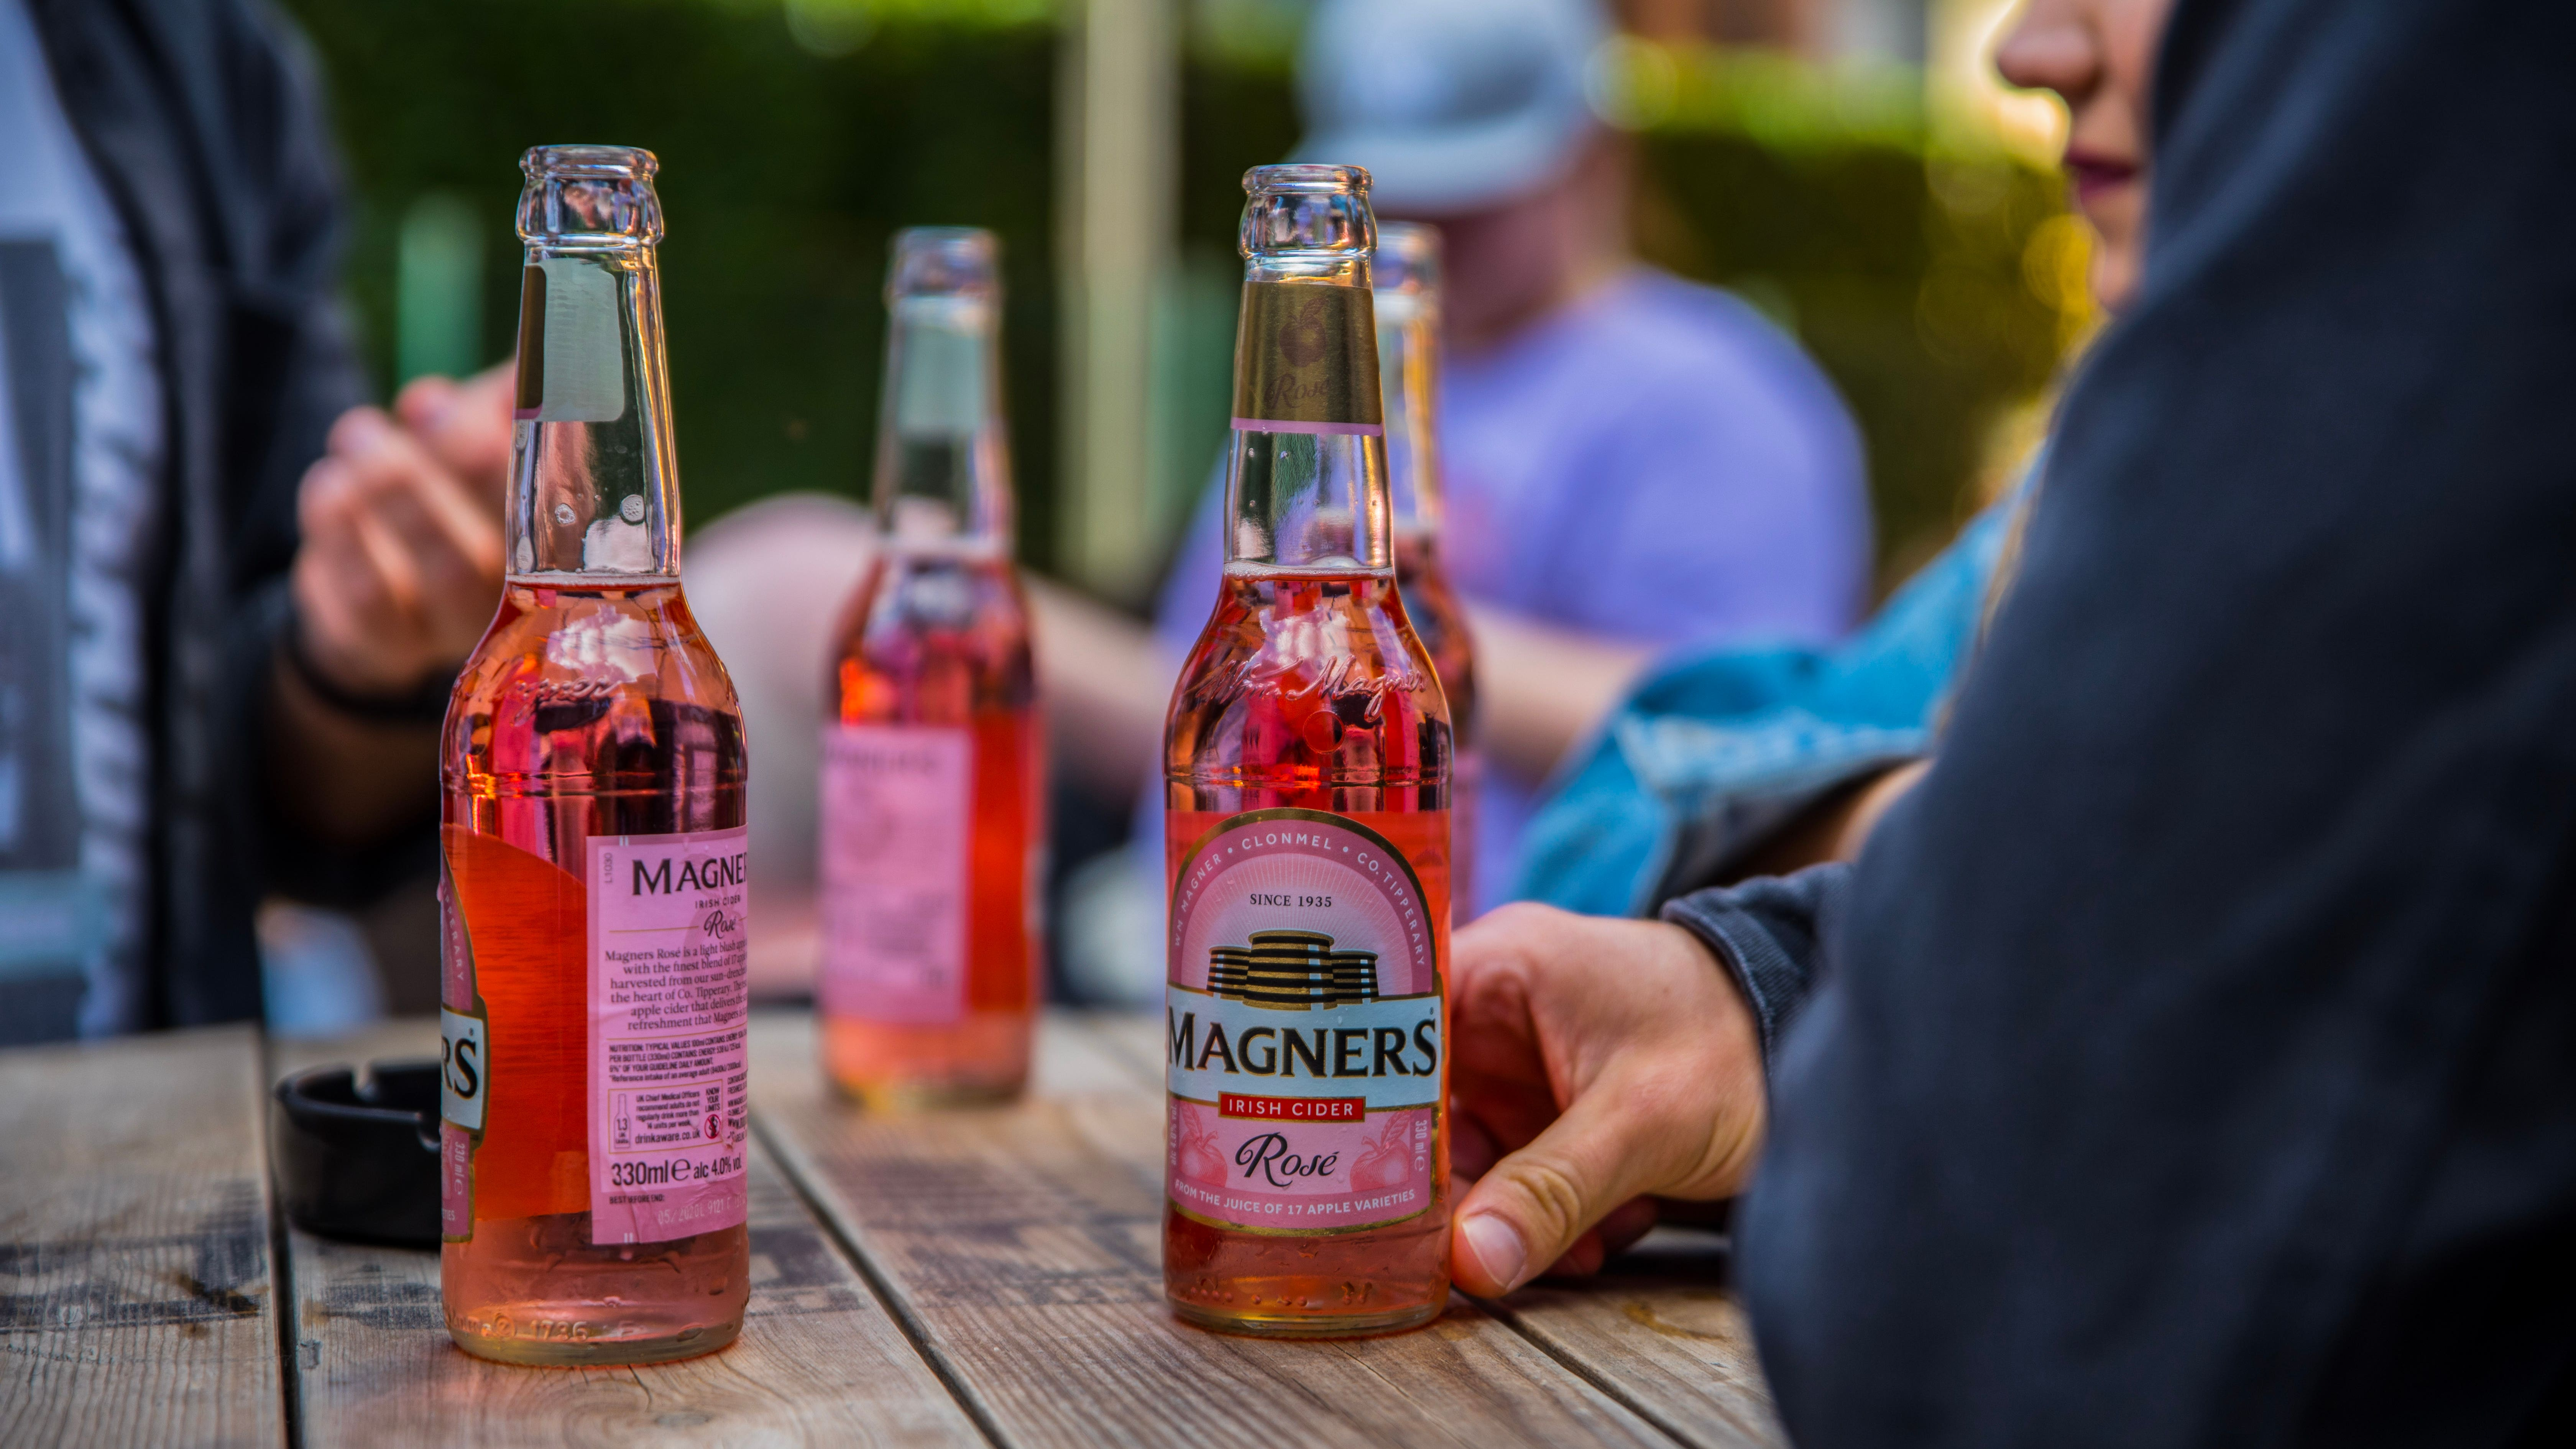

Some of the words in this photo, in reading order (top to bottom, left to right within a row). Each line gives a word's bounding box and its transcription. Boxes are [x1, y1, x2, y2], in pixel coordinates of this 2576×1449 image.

[1181, 853, 1221, 912] MAGNER
[1242, 833, 1332, 850] CLONMEL
[695, 900, 720, 909] IRISH
[723, 894, 741, 906] CIDER
[1250, 894, 1291, 907] SINCE
[1298, 895, 1332, 907] 1935
[606, 950, 654, 963] Magners
[657, 947, 680, 959] Rosé
[683, 946, 690, 957] is
[700, 943, 718, 958] light
[720, 940, 735, 952] blush
[623, 962, 650, 974] with
[653, 962, 670, 973] the
[674, 959, 699, 971] finest
[702, 955, 722, 968] blend
[724, 955, 730, 966] of
[611, 975, 665, 989] harvested
[669, 974, 692, 986] from
[694, 975, 708, 984] our
[611, 992, 629, 1003] the
[633, 990, 662, 1002] heart
[665, 989, 675, 1000] of
[678, 989, 692, 999] Co.
[695, 985, 732, 1000] Tipperary.
[631, 1004, 661, 1019] apple
[664, 1001, 688, 1014] cider
[692, 999, 708, 1011] that
[710, 997, 735, 1009] delivers
[628, 1016, 692, 1030] refreshment
[695, 1014, 711, 1025] that
[714, 1010, 738, 1024] Magners
[646, 1042, 669, 1051] TYPICAL
[671, 1040, 690, 1049] VALUES
[1168, 1005, 1437, 1079] MAGNERS
[623, 1053, 646, 1062] BOTTLE
[632, 1063, 648, 1071] YOUR
[649, 1061, 678, 1071] GUIDELINE
[679, 1060, 693, 1068] DAILY
[661, 1092, 680, 1101] Medical
[706, 1087, 720, 1095] KNOW
[636, 1103, 668, 1111] recommend
[707, 1096, 719, 1104] YOUR
[1229, 1098, 1281, 1116] IRISH
[1292, 1102, 1354, 1116] CIDER
[705, 1104, 720, 1113] LIMITS
[636, 1113, 660, 1122] regularly
[635, 1128, 700, 1144] drinkaware.co.uk
[1415, 1119, 1428, 1139] 330
[455, 1142, 465, 1163] 330
[1234, 1132, 1341, 1188] Rosé
[611, 1160, 669, 1186] 330ml
[693, 1162, 708, 1179] alc
[711, 1156, 731, 1176] 4.0%
[610, 1195, 626, 1204] BEST
[1175, 1178, 1196, 1198] FROM
[1199, 1190, 1220, 1206] THE
[1224, 1198, 1260, 1212] JUICE
[1265, 1203, 1283, 1214] OF
[1288, 1205, 1303, 1215] 17
[1307, 1202, 1350, 1214] APPLE
[1354, 1189, 1415, 1211] VARIETIES
